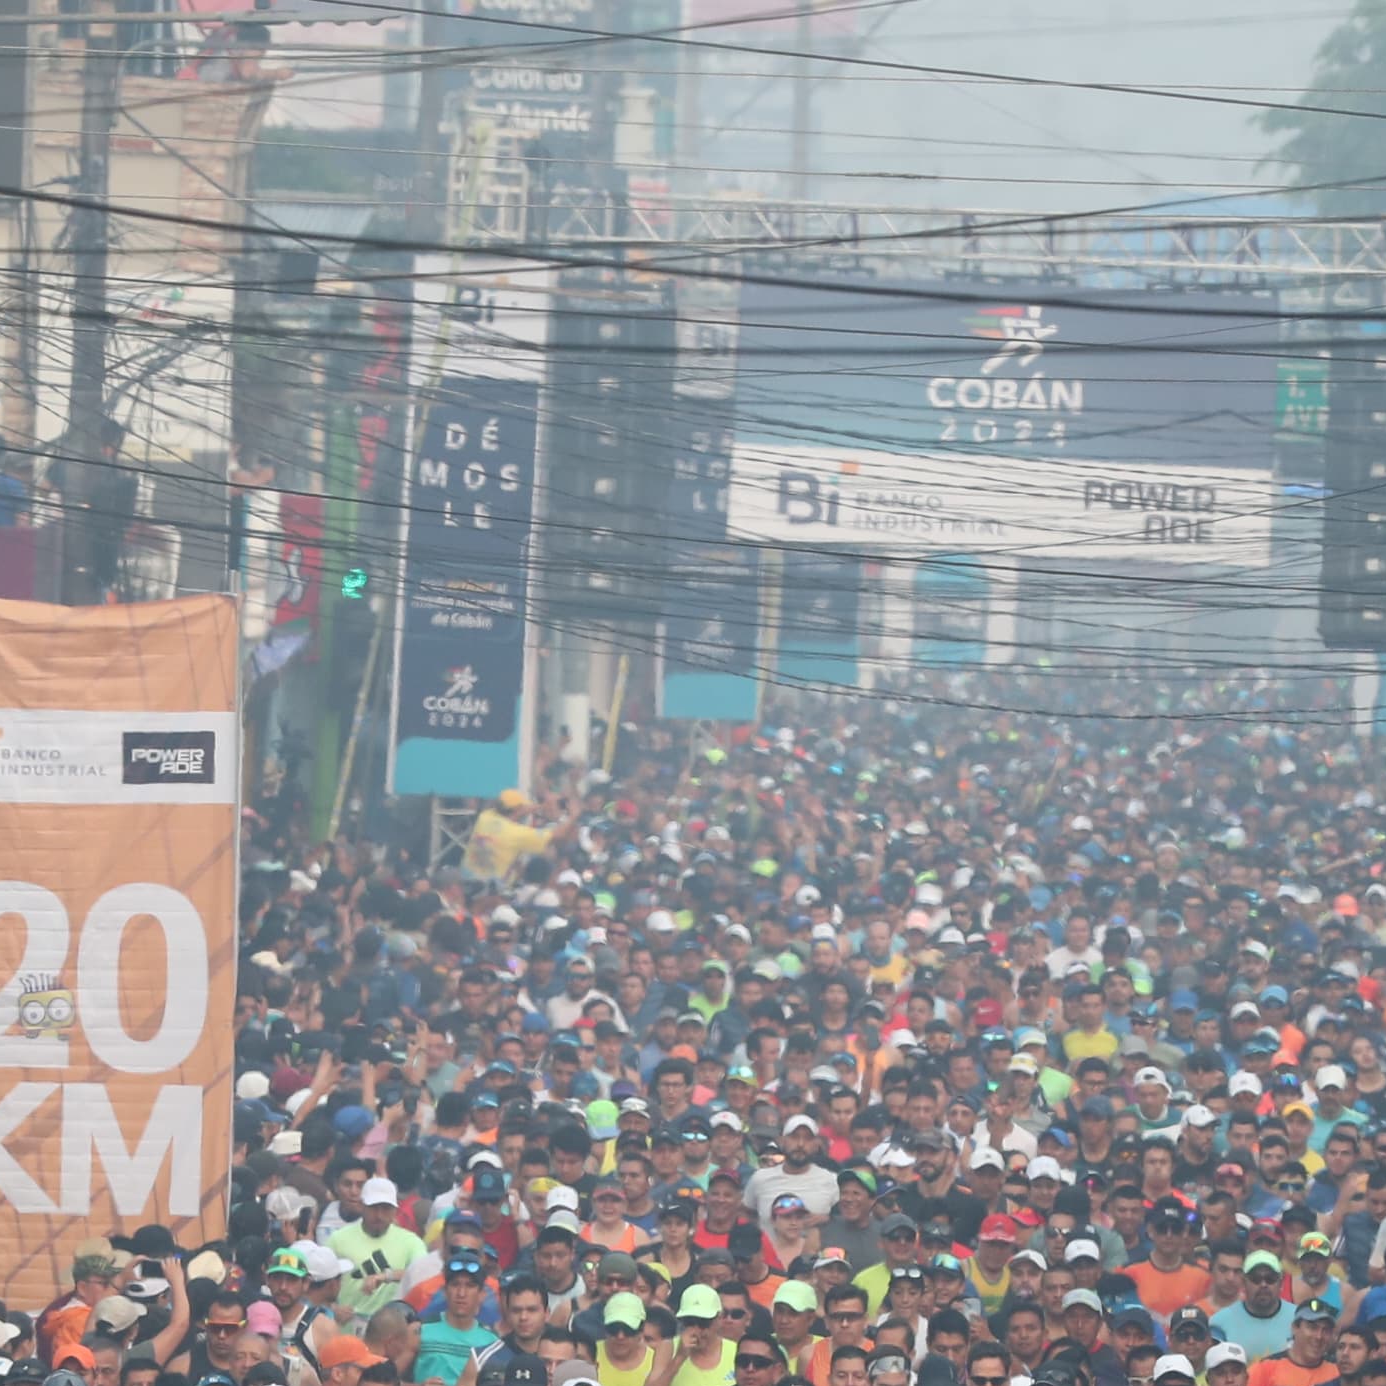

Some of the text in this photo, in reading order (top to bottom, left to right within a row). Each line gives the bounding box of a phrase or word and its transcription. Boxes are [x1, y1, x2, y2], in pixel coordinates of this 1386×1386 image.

[926, 371, 1084, 415] COBÁN
[776, 469, 839, 526] Bi
[854, 490, 943, 510] BANCO
[1084, 479, 1216, 513] POWER
[853, 514, 1009, 536] INDUSTRIAL
[423, 695, 490, 715] COBÁN
[1, 748, 61, 760] BANCO
[131, 748, 205, 763] POWER
[0, 764, 107, 777] INDUSTRIAL
[159, 761, 204, 774] ADE
